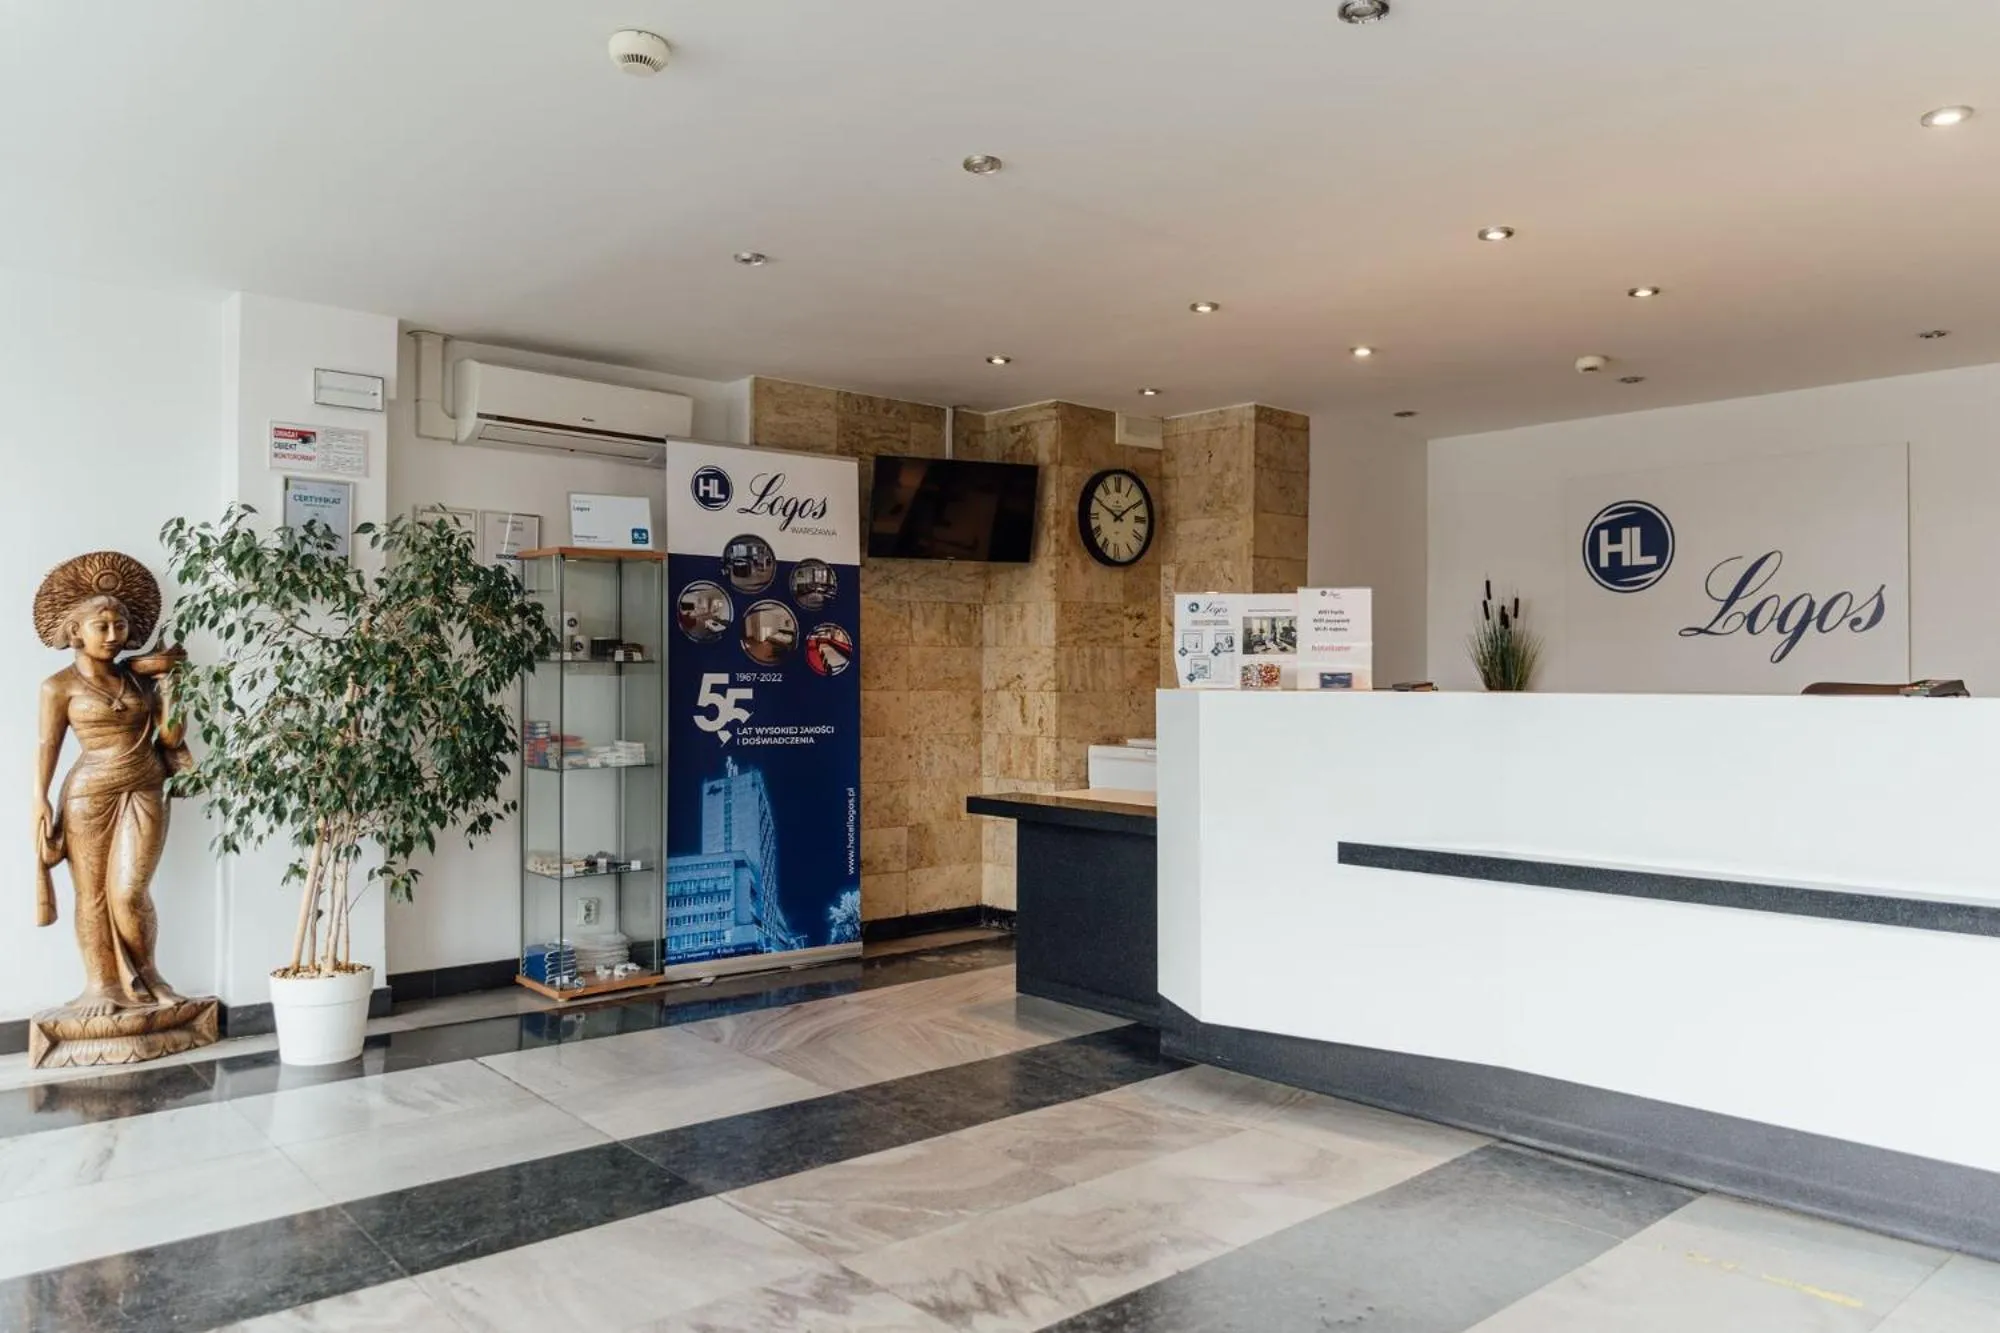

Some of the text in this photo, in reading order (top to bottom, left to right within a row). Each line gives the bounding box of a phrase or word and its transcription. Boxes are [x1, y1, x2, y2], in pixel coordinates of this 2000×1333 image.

[699, 477, 726, 499] HL
[293, 494, 341, 505] CERTYFIKAT
[737, 473, 828, 532] Logos
[791, 526, 838, 537] WARSZAWA
[1599, 526, 1657, 568] HL
[1678, 550, 1887, 664] Logos
[735, 672, 783, 682] 1967-2022
[693, 673, 754, 742] 55
[737, 724, 835, 735] LAT WYSOKIEJ JAKOŚCI
[742, 736, 815, 746] DOŚWIADCZENIA
[846, 786, 857, 876] www.hotellogos.pl
